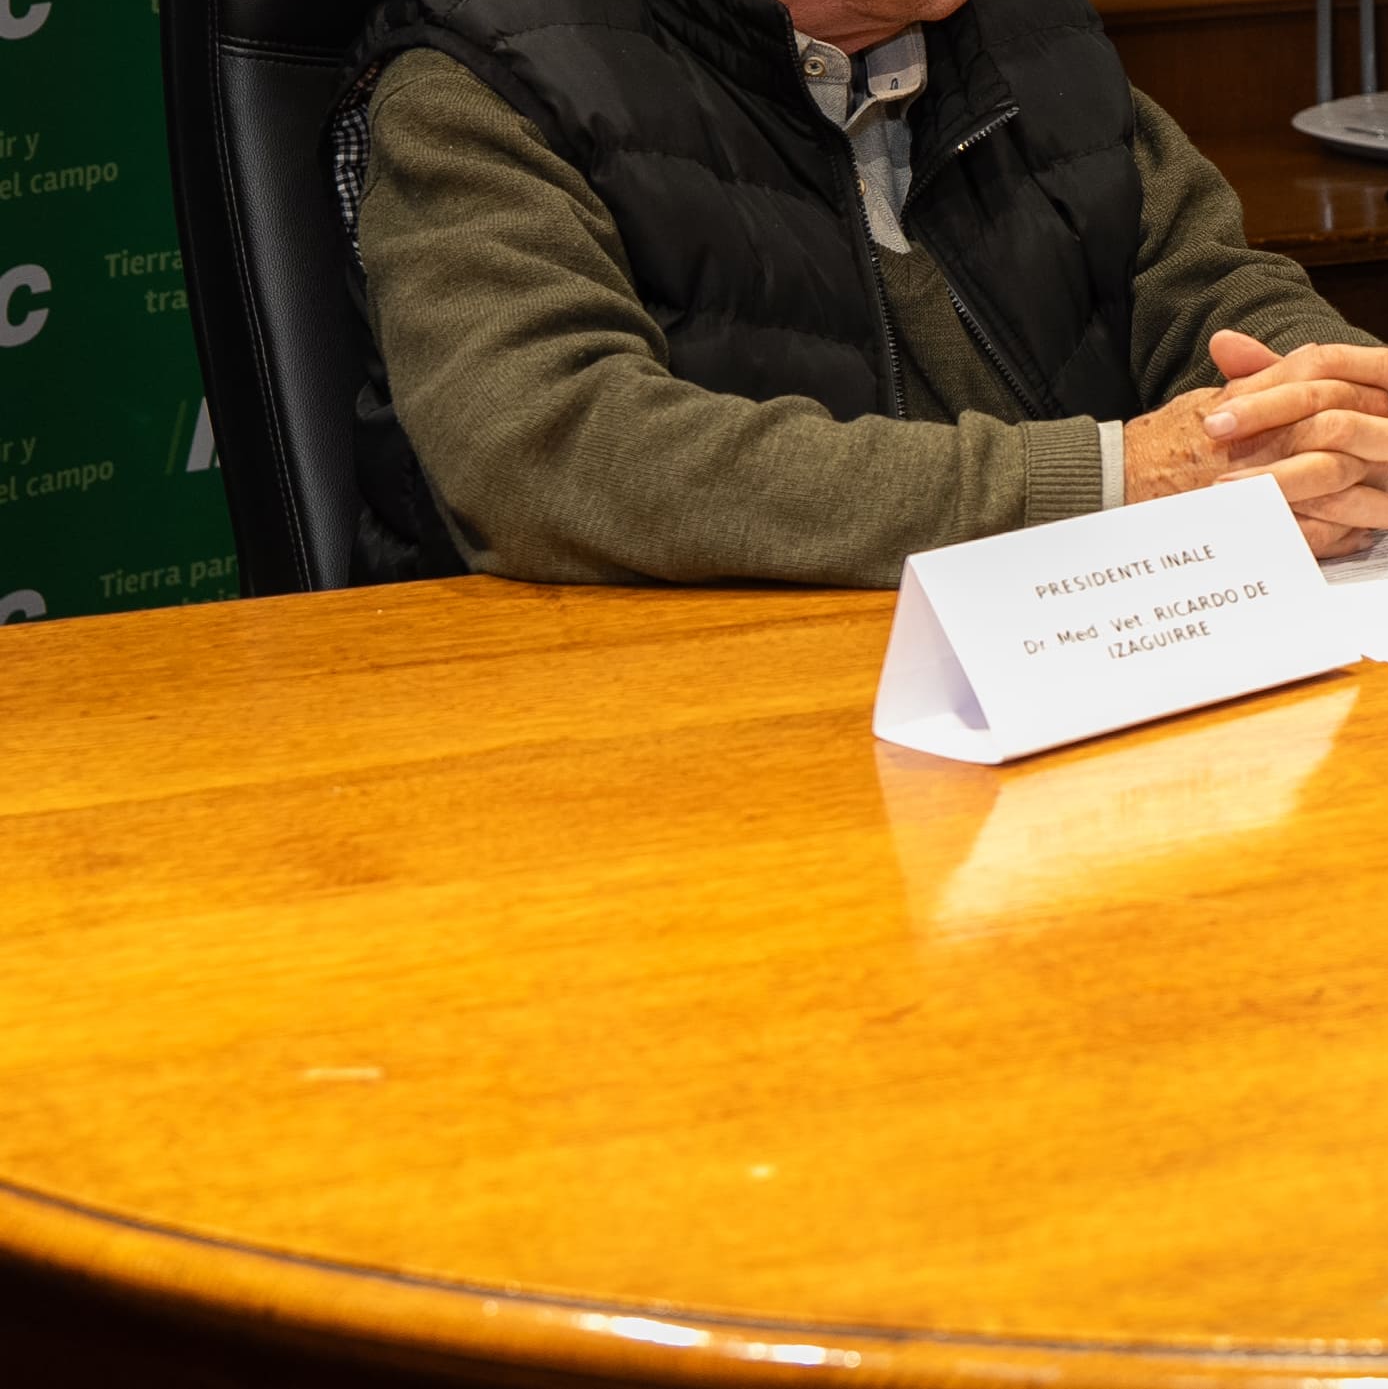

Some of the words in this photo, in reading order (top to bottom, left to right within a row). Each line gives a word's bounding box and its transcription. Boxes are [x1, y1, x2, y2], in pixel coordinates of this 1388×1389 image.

[24, 132, 40, 161] y
[29, 162, 119, 194] campo
[20, 435, 37, 465] y
[26, 460, 114, 497] campo
[99, 565, 182, 598] Tierra
[189, 554, 238, 588] par
[1034, 559, 1155, 599] PRESIDENTE
[1160, 544, 1215, 569] INALE
[1153, 588, 1239, 621] RICARDO
[1242, 580, 1269, 600] DE
[1107, 618, 1211, 659] IZAGUIRRE
